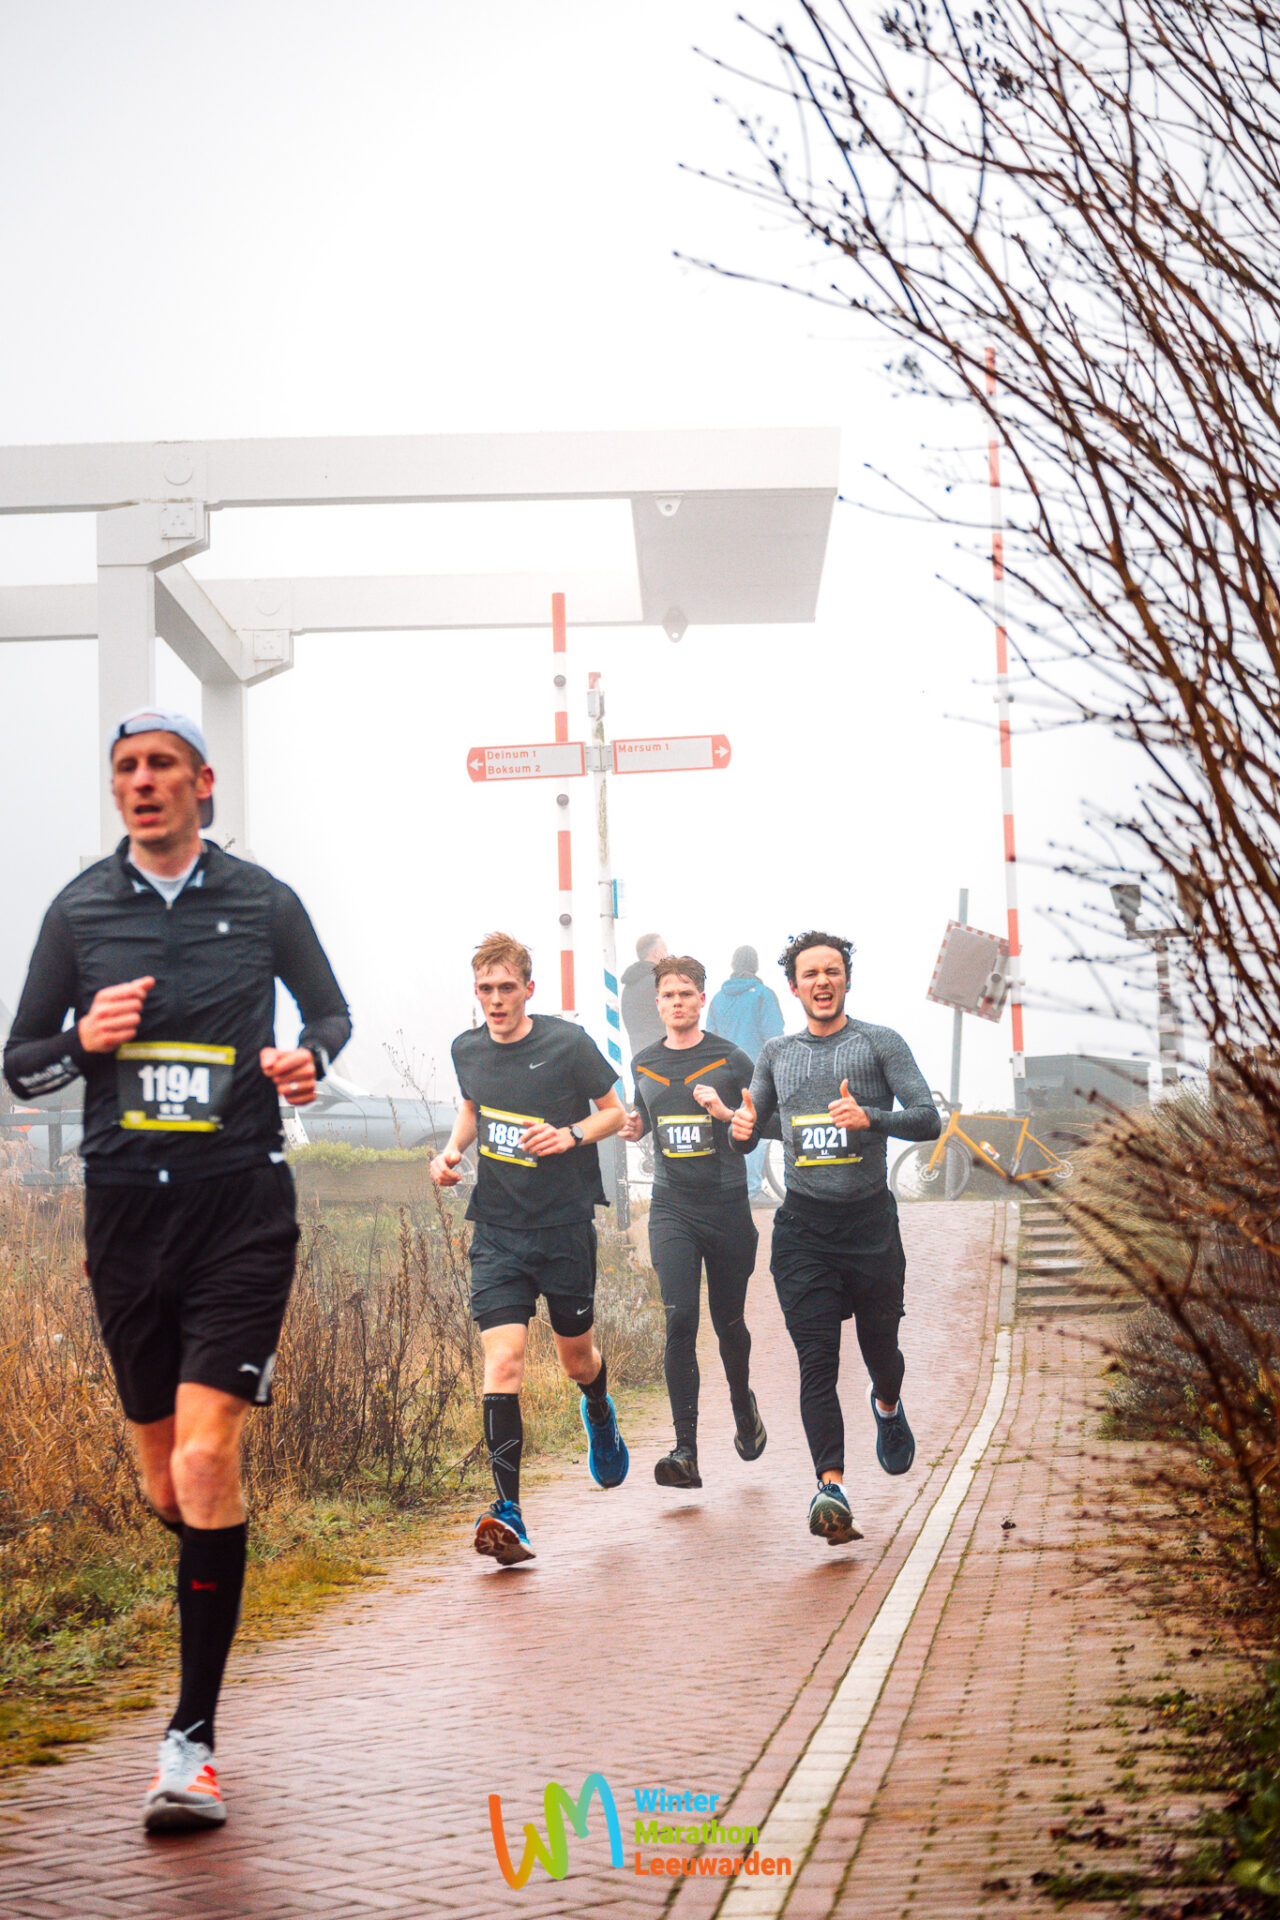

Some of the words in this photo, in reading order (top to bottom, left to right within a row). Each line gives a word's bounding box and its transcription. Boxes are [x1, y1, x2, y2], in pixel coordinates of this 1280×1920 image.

[618, 743, 661, 752] Marsum
[487, 751, 529, 760] Deinum
[487, 764, 531, 775] Boksum
[535, 764, 541, 772] 2
[138, 1064, 210, 1104] 1194
[666, 1126, 701, 1144] 1144
[801, 1126, 848, 1150] 2021
